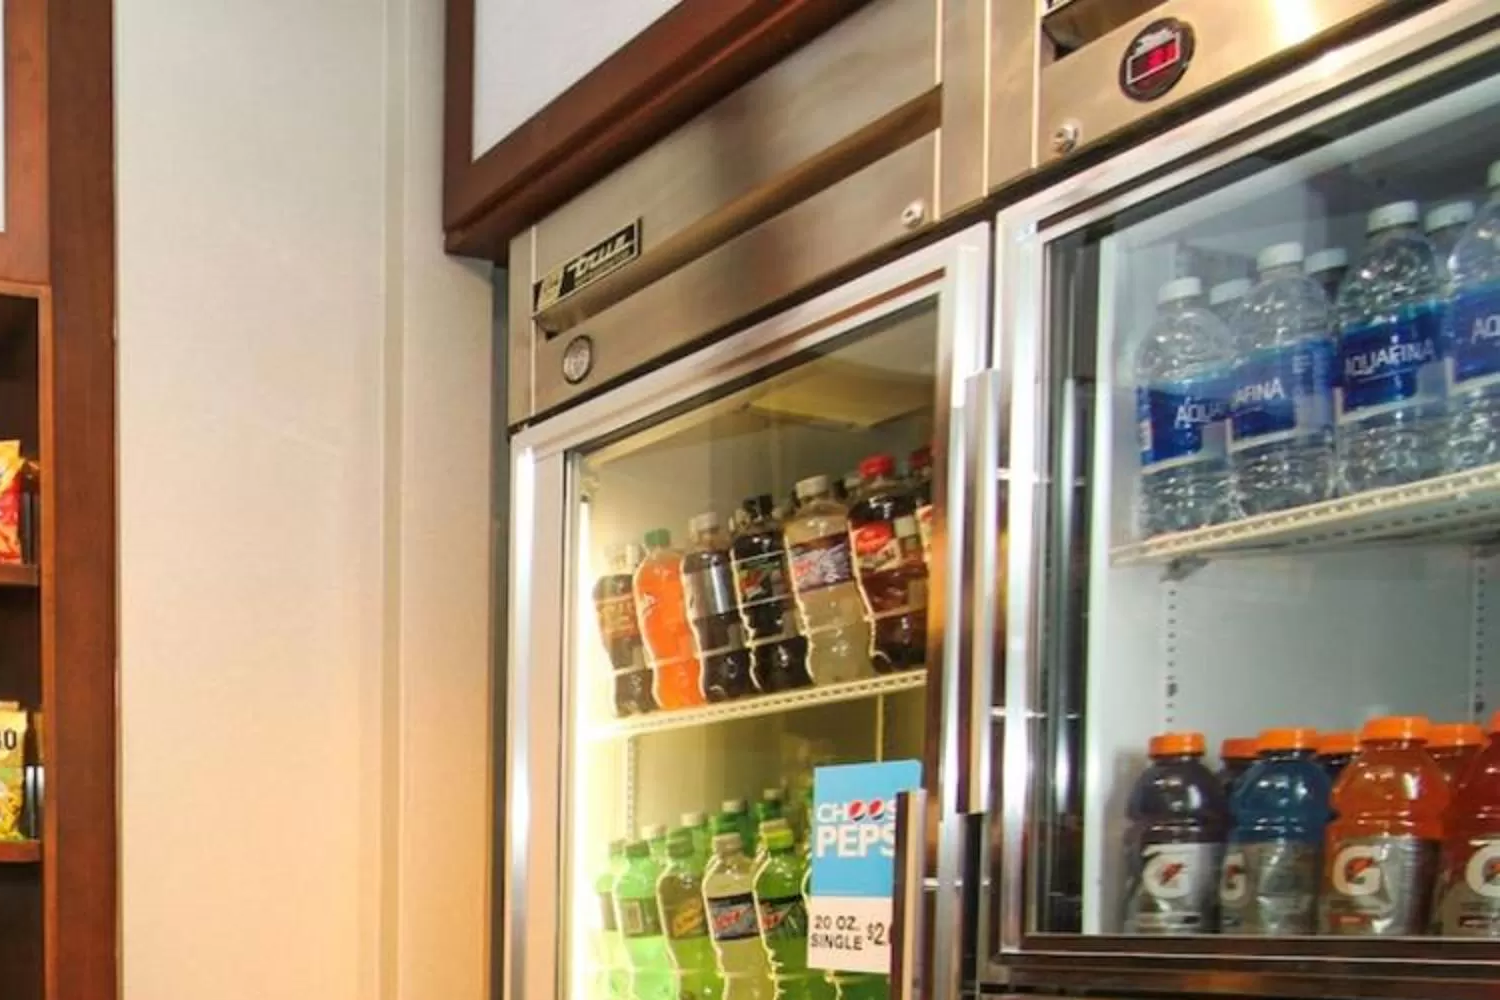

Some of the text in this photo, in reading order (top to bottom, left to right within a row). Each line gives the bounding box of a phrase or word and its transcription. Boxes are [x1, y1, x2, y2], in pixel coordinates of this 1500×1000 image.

[1344, 340, 1436, 378] AQUAFINA
[817, 799, 896, 823] CHOOS
[816, 824, 895, 858] PEPS
[814, 915, 832, 930] 20
[811, 932, 863, 951] SINGLE
